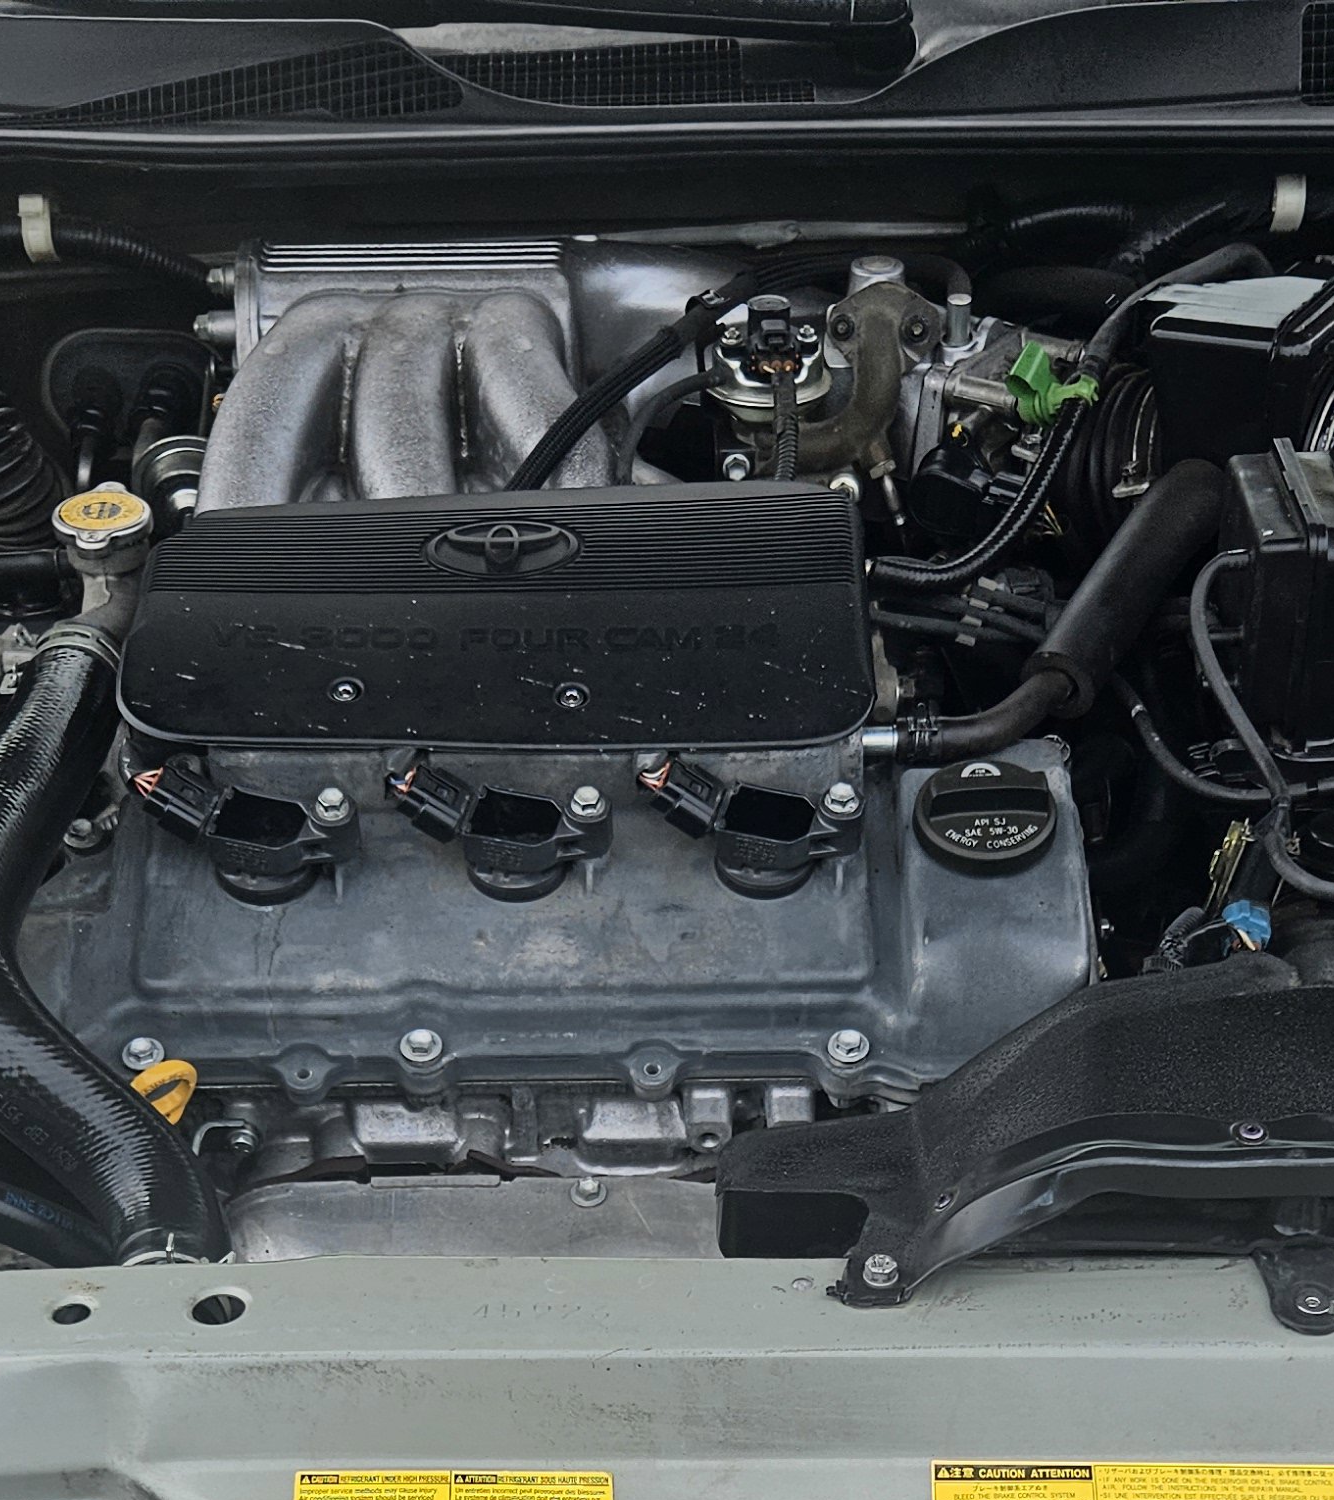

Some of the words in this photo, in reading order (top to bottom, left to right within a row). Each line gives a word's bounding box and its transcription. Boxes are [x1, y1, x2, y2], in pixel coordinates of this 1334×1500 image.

[459, 626, 591, 652] FOUR
[604, 626, 702, 652] CAM
[975, 818, 990, 827] API
[994, 818, 1006, 826] SJ
[945, 829, 979, 848] ENERGY
[986, 824, 1039, 850] CONSERVING
[965, 828, 983, 837] SAE
[989, 826, 1019, 835] 5W-30
[949, 1466, 974, 1478] 注意
[979, 1468, 1026, 1479] CAUTION
[1030, 1468, 1090, 1479] ATTENTION
[418, 1476, 449, 1484] PRESSURE
[558, 1476, 578, 1484] HAUTE
[579, 1476, 609, 1484] PRESSION
[299, 1487, 330, 1495] Improper
[330, 1487, 353, 1495] service
[354, 1487, 382, 1495] methods
[384, 1487, 398, 1495] may
[399, 1487, 418, 1495] cause
